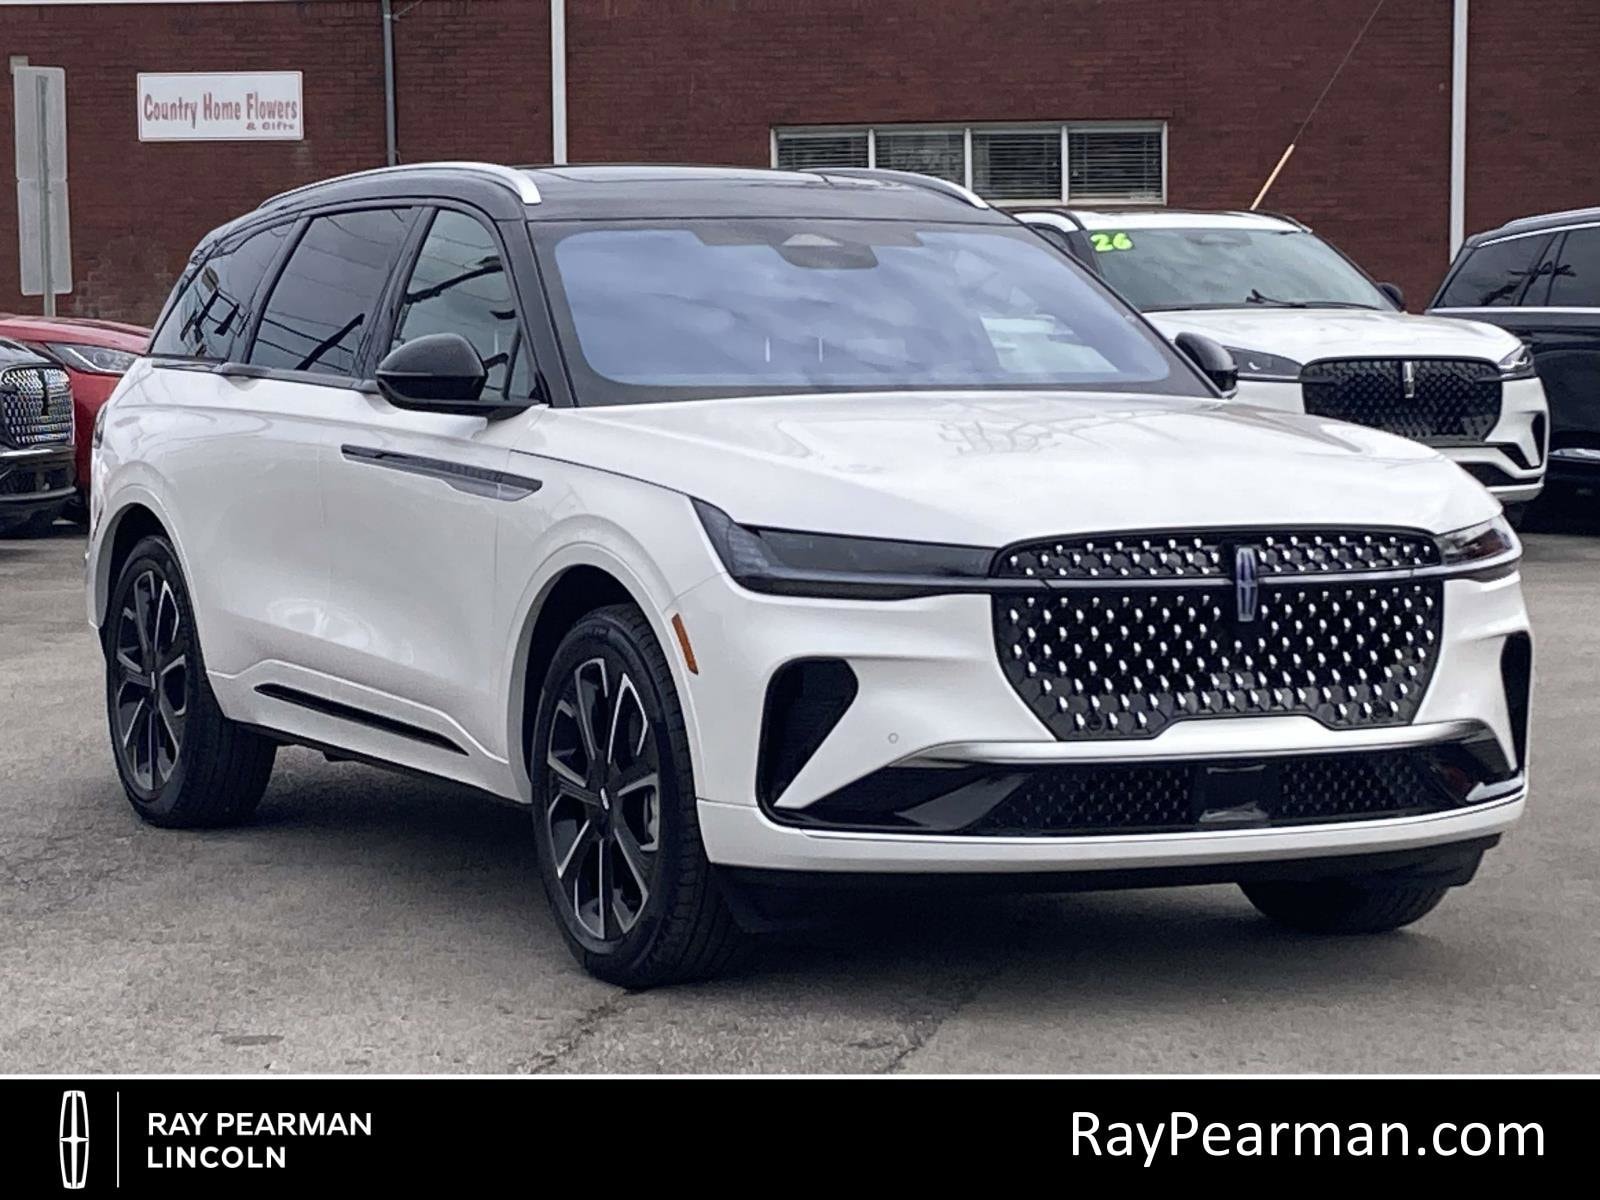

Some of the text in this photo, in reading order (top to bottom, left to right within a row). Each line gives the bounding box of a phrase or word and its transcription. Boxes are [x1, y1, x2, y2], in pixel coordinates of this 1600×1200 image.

[144, 91, 298, 129] Country Home Flowers
[246, 121, 296, 131] & Gifts
[1090, 232, 1133, 252] 26
